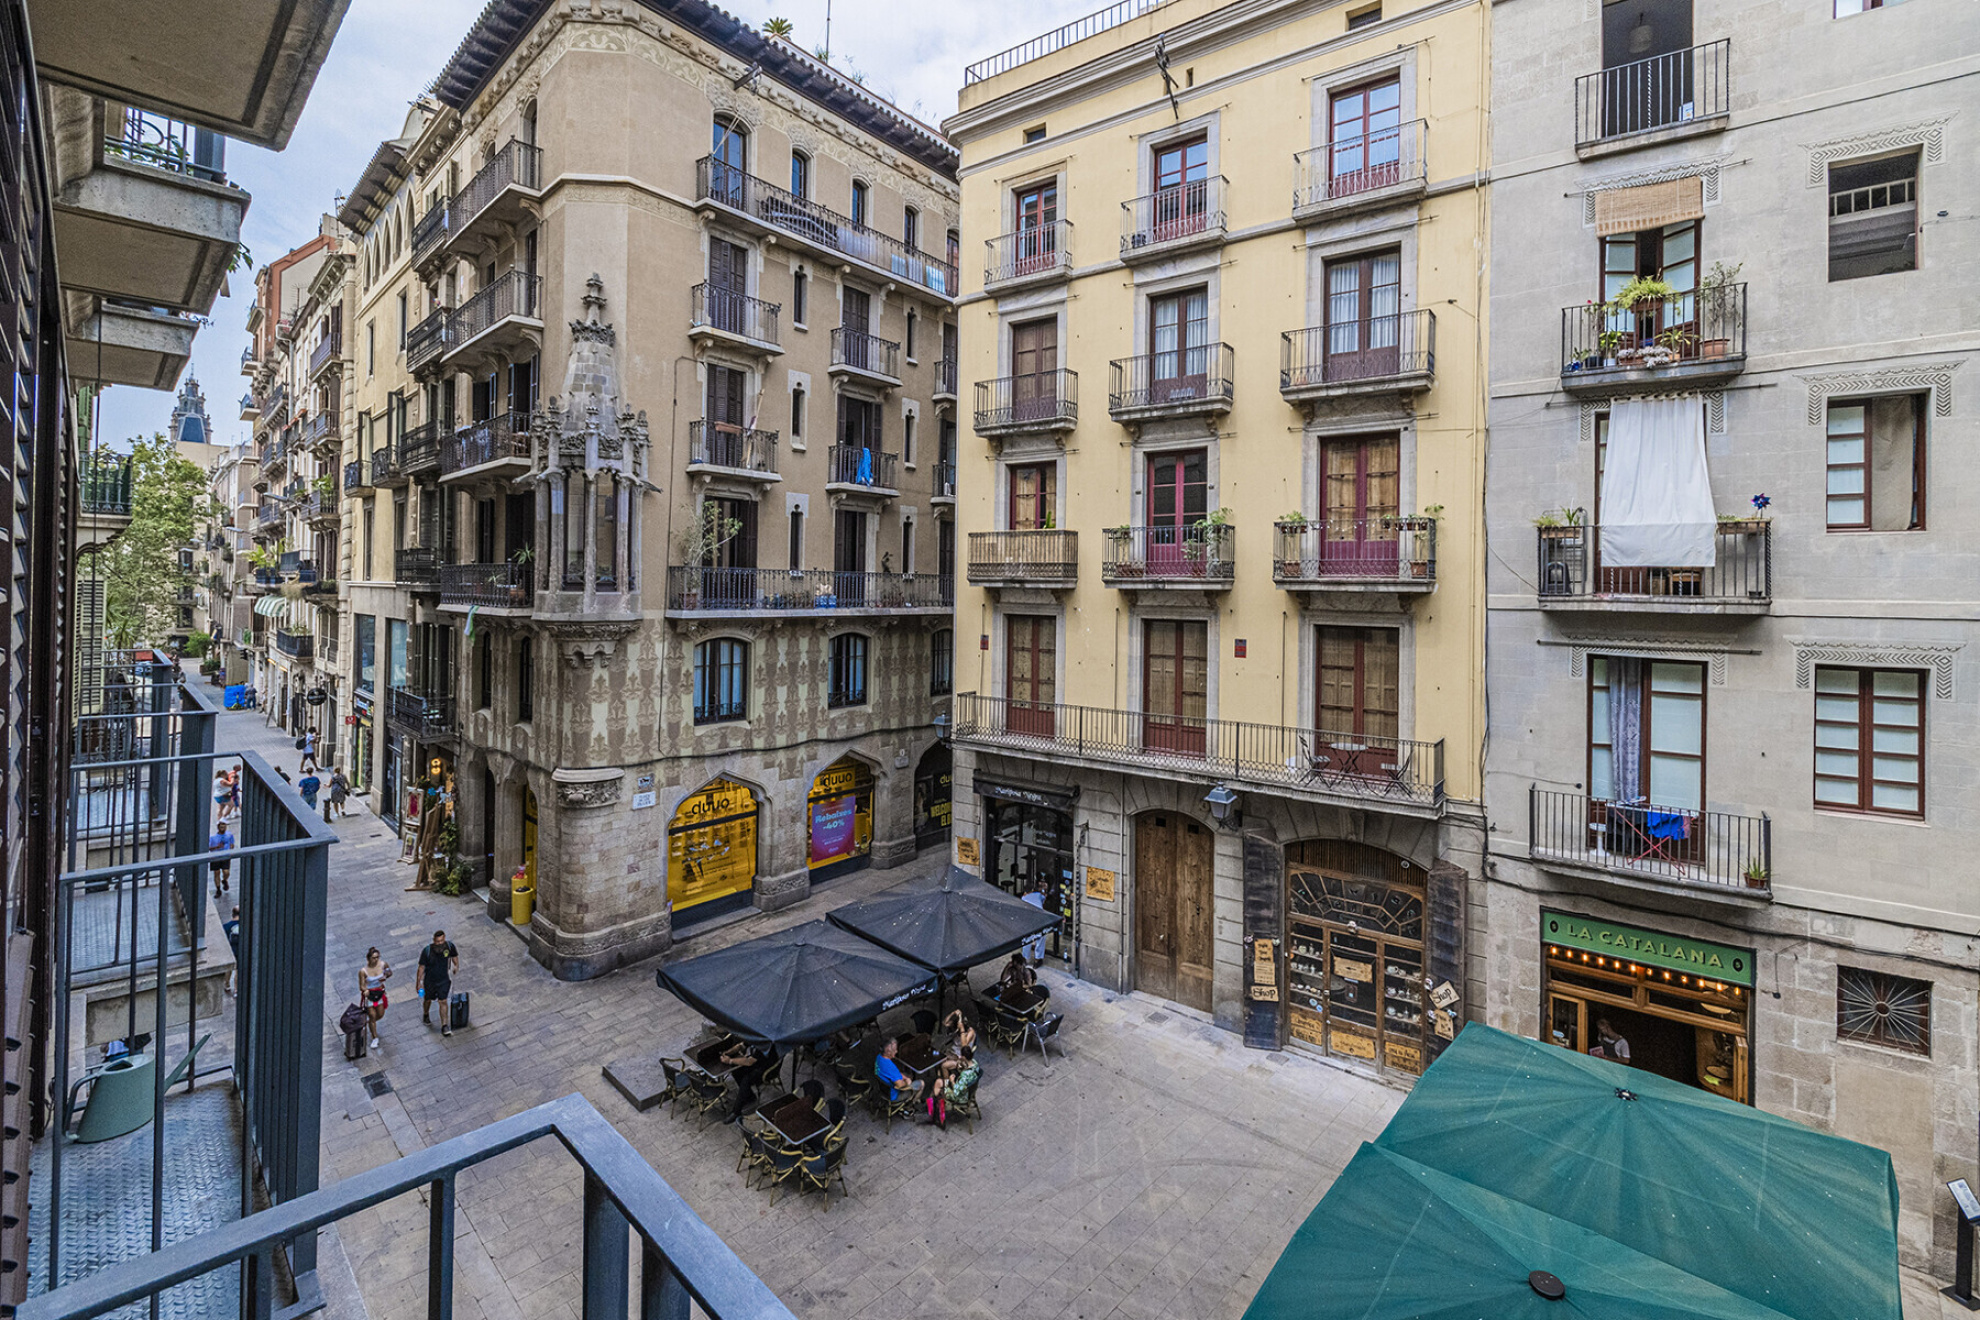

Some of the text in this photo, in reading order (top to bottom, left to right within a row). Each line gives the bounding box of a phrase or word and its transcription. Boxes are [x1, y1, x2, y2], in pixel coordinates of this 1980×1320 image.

[823, 772, 853, 787] duuo
[691, 798, 730, 815] duuo
[1567, 924, 1724, 968] LA CATALANA
[1252, 987, 1276, 999] Shop
[1431, 988, 1453, 1004] Shop
